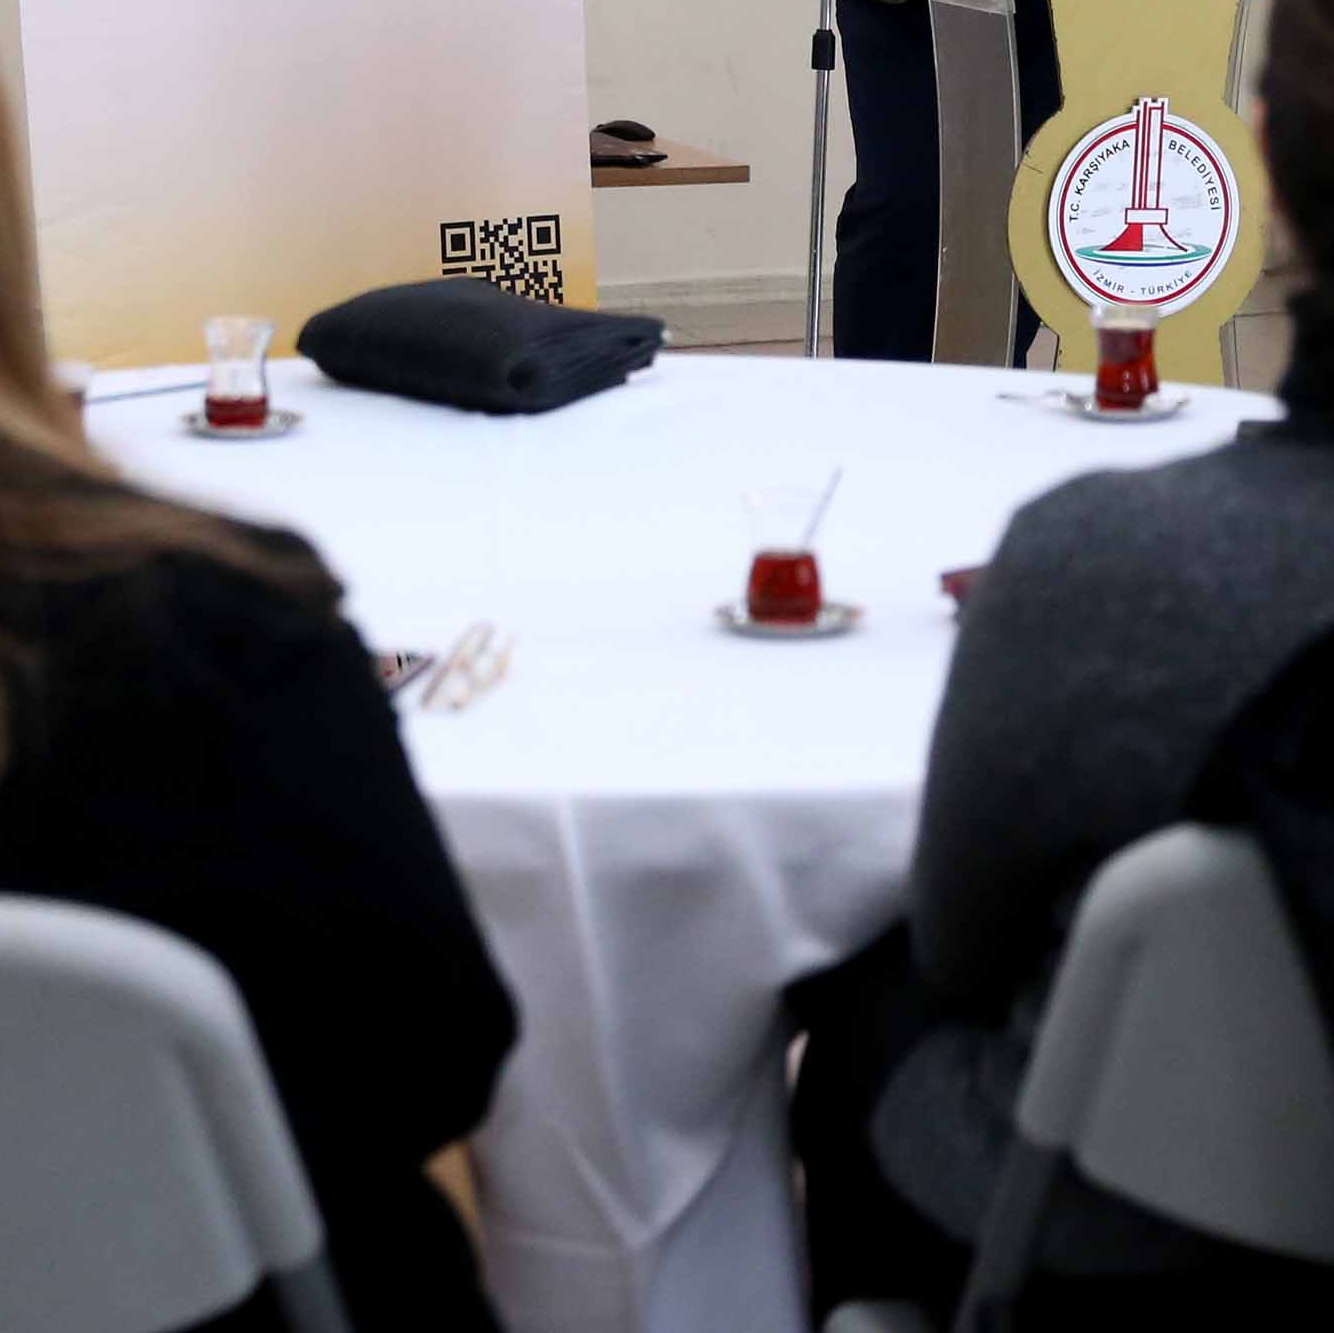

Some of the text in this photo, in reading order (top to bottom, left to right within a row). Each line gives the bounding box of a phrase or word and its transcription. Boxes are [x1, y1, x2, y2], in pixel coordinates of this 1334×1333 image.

[1068, 139, 1222, 223] T.C. KARŞIYAKA BELEDİYESİ
[1093, 269, 1125, 294] İZMİR
[1140, 271, 1192, 295] TÜRKİYE
